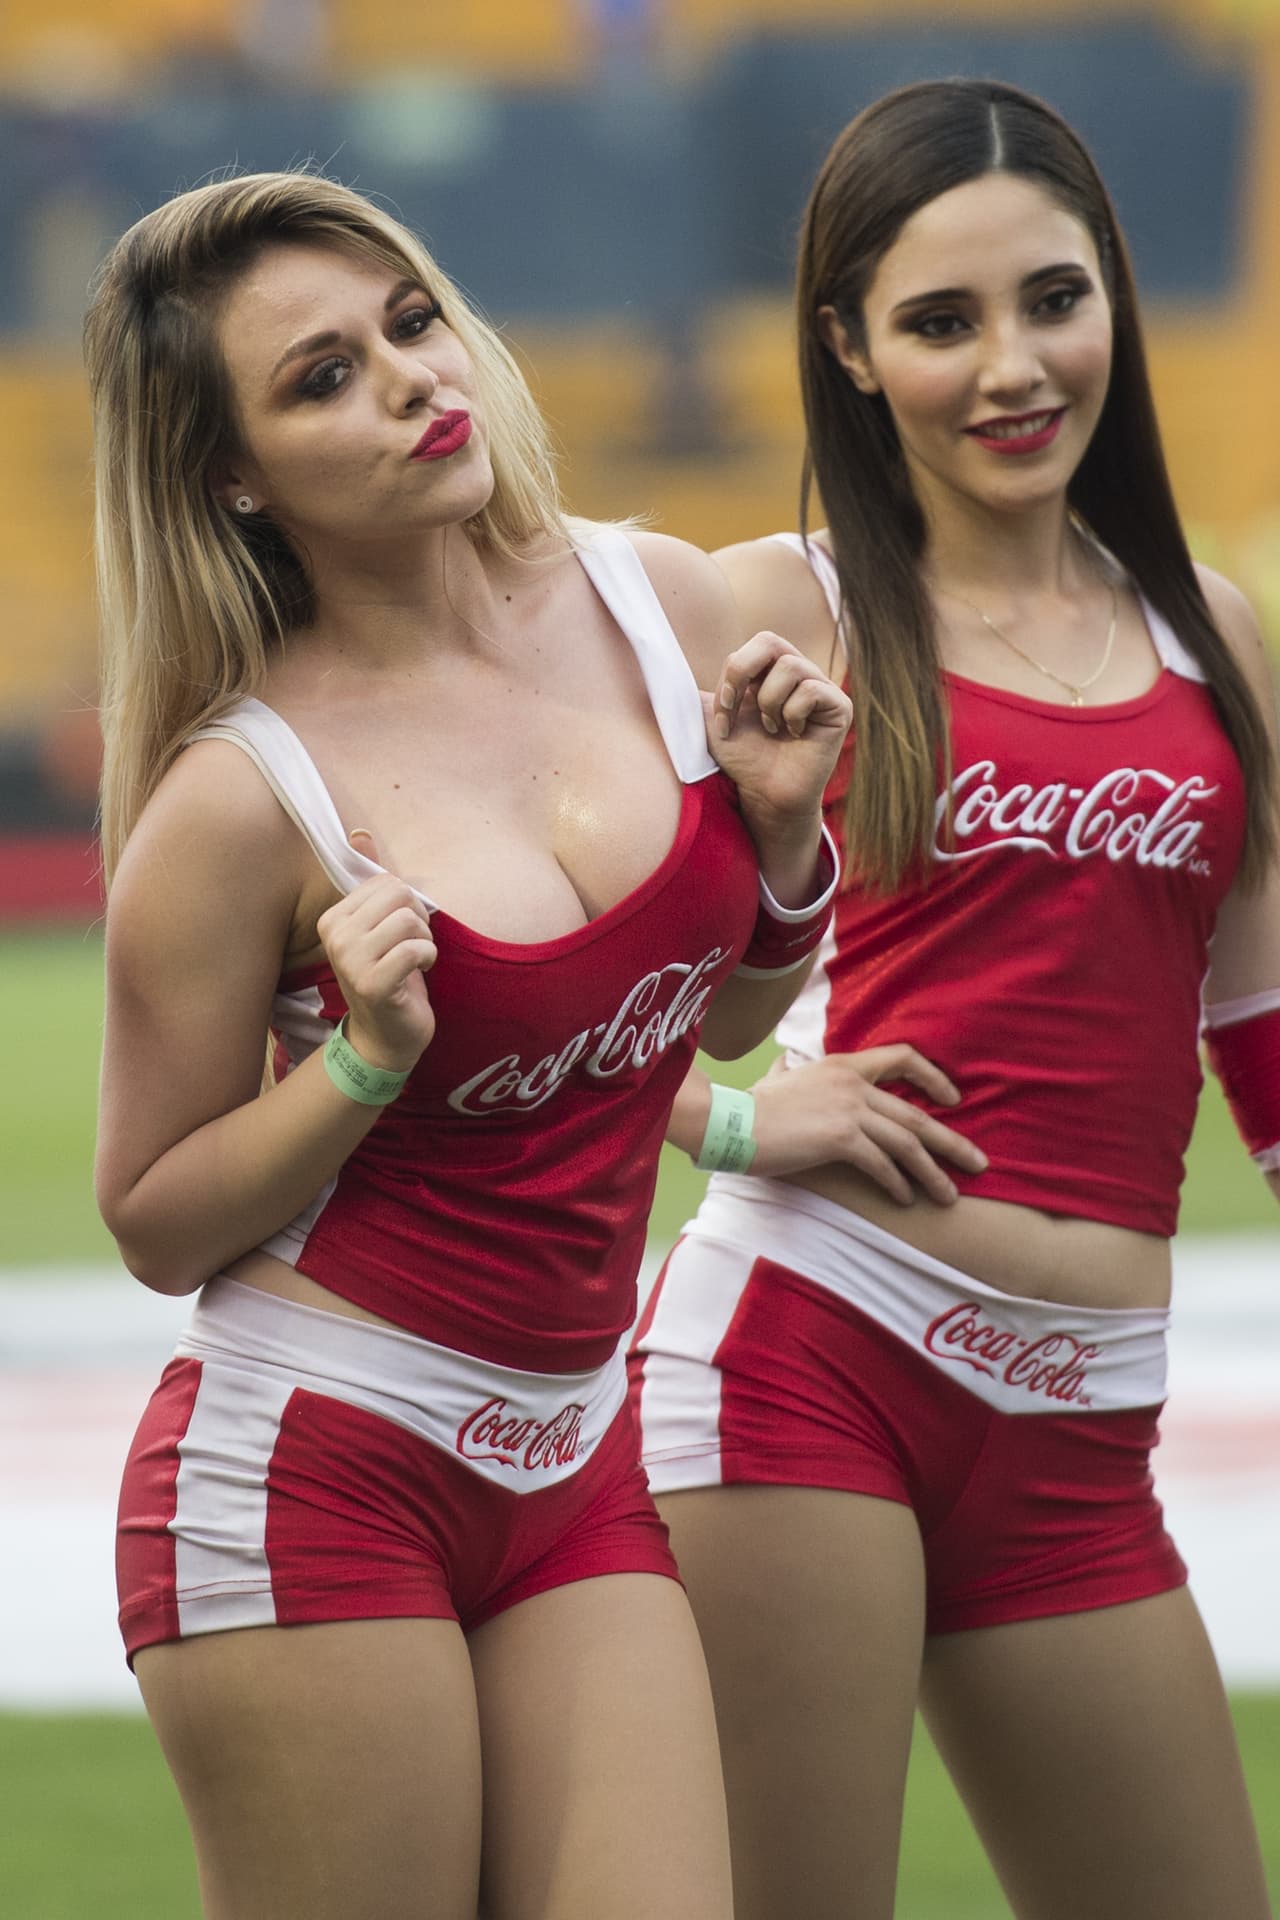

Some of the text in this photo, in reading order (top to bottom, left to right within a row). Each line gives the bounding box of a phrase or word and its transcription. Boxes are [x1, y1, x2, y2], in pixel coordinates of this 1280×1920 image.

[934, 760, 1220, 869] Coca-Cola
[448, 944, 735, 1116] Coca-Cola
[924, 1302, 1104, 1402] Coca-Cola
[456, 1396, 588, 1472] Coca-Cola
